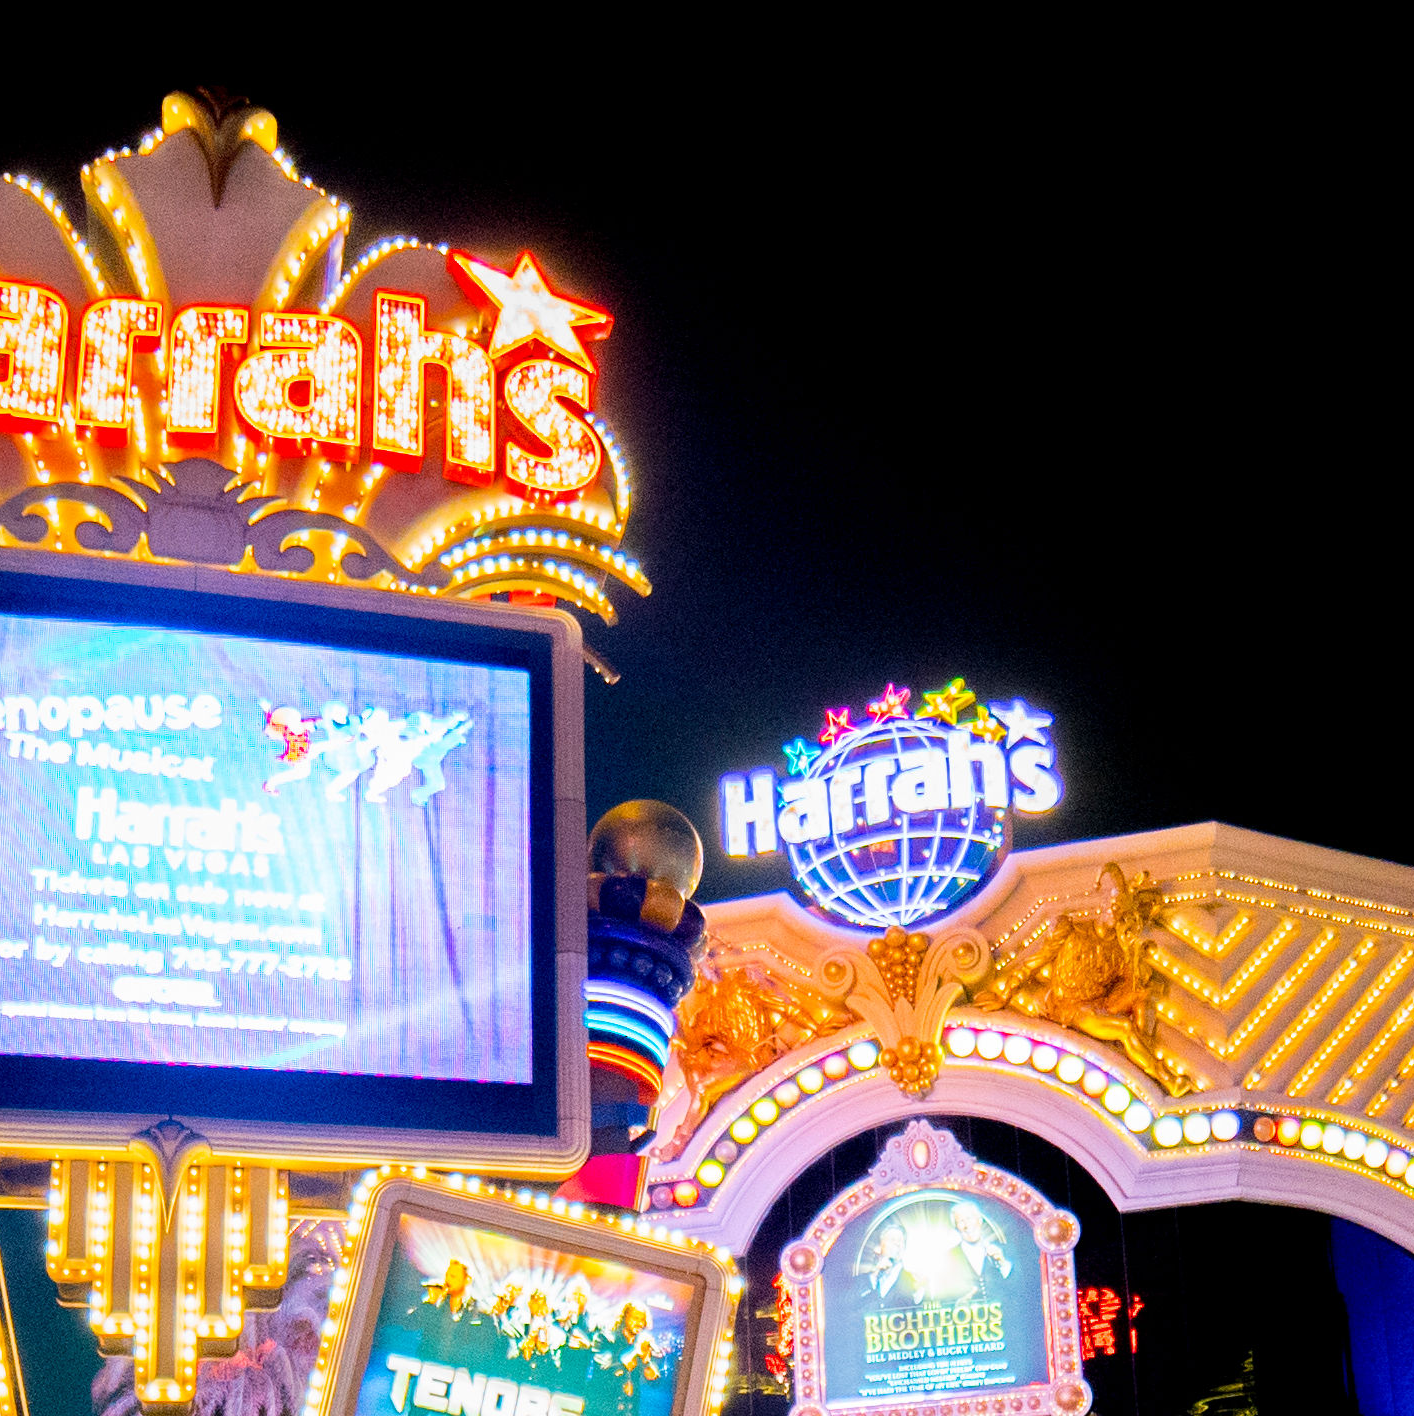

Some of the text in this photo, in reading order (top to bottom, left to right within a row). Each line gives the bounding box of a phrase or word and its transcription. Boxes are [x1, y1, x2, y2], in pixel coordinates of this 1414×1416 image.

[5, 731, 216, 782] The Musical
[92, 842, 270, 878] LAS VEGAS
[31, 868, 128, 897] Tickets
[135, 882, 169, 899] on
[176, 880, 229, 904] sale
[234, 890, 293, 909] now
[36, 936, 72, 967] by
[77, 941, 164, 974] calling
[864, 1302, 1004, 1335] RIGHTEOUS
[923, 1301, 942, 1311] THE
[865, 1320, 1005, 1354] BROTHERS
[866, 1341, 1006, 1363] BILL MEDLEY & BUCKY HEARD
